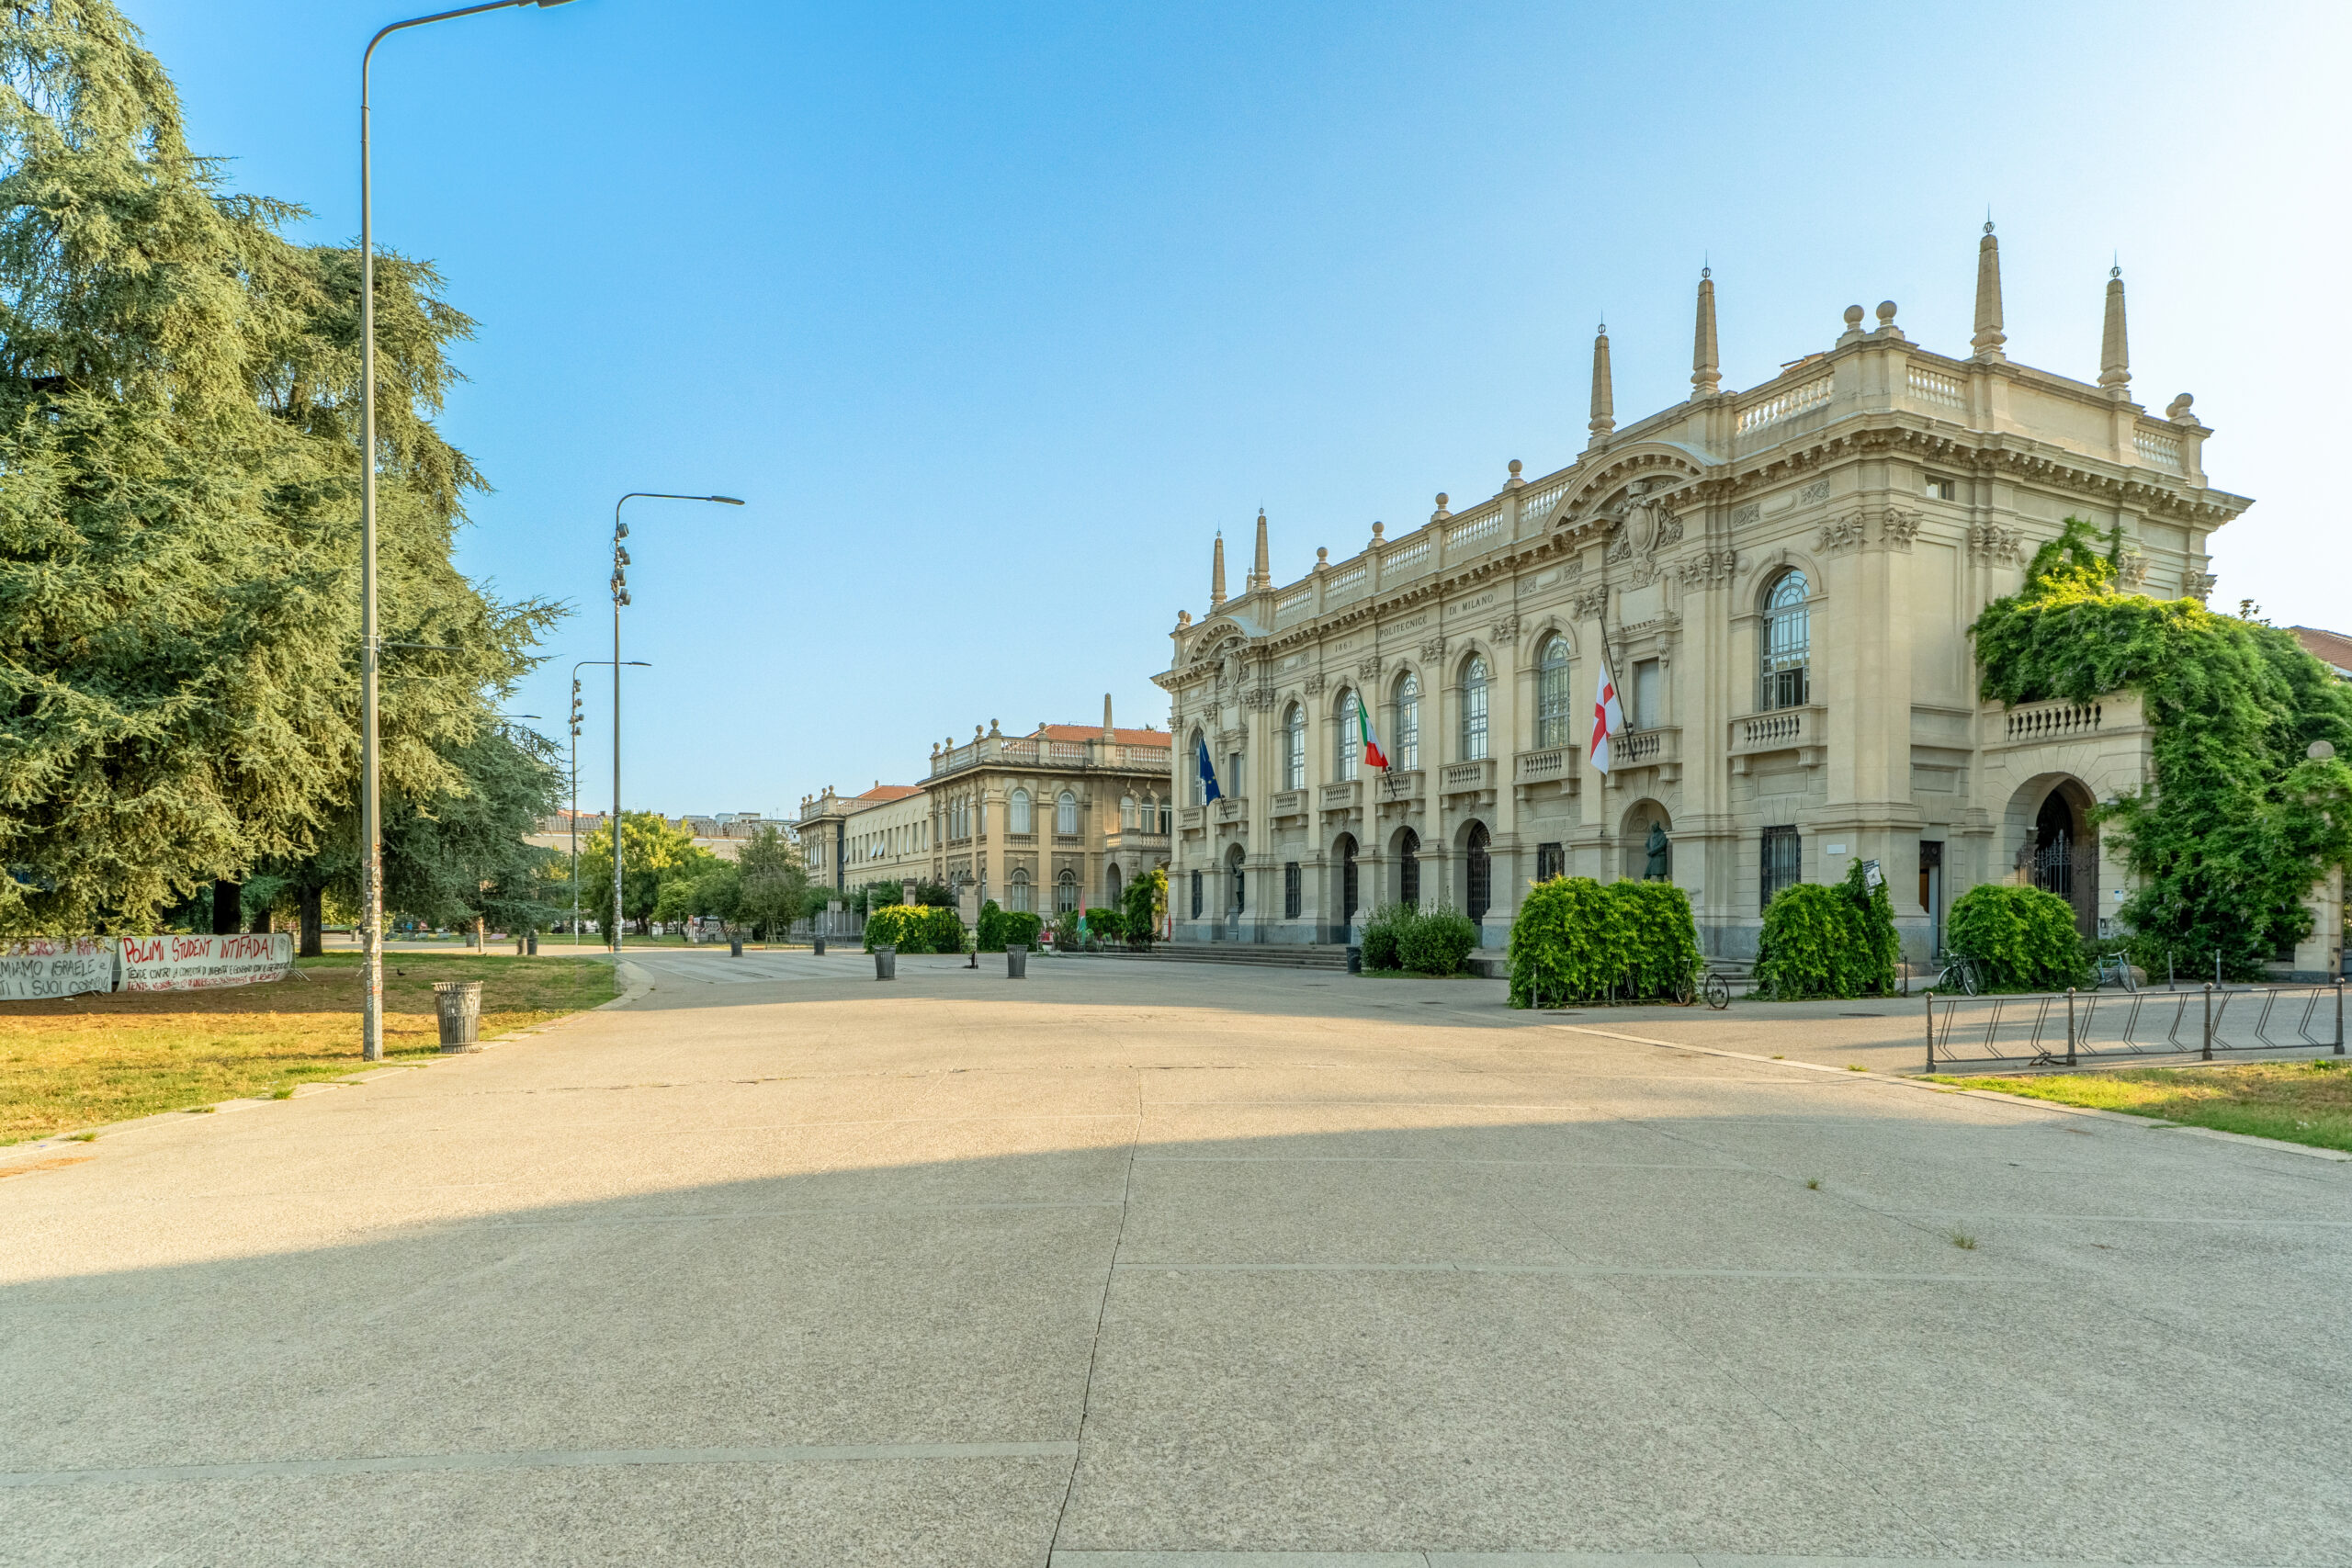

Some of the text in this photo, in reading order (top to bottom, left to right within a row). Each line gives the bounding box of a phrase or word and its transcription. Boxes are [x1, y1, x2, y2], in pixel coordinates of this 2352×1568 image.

[1449, 606, 1457, 615] DI
[1463, 594, 1494, 612] MILANO
[123, 937, 164, 964] POLIMI
[172, 937, 212, 963] STUDENT
[220, 935, 275, 961] INTIFADA!
[0, 959, 43, 978] MIAMO
[51, 959, 96, 976] ISRAELE
[31, 979, 63, 997] SUOI
